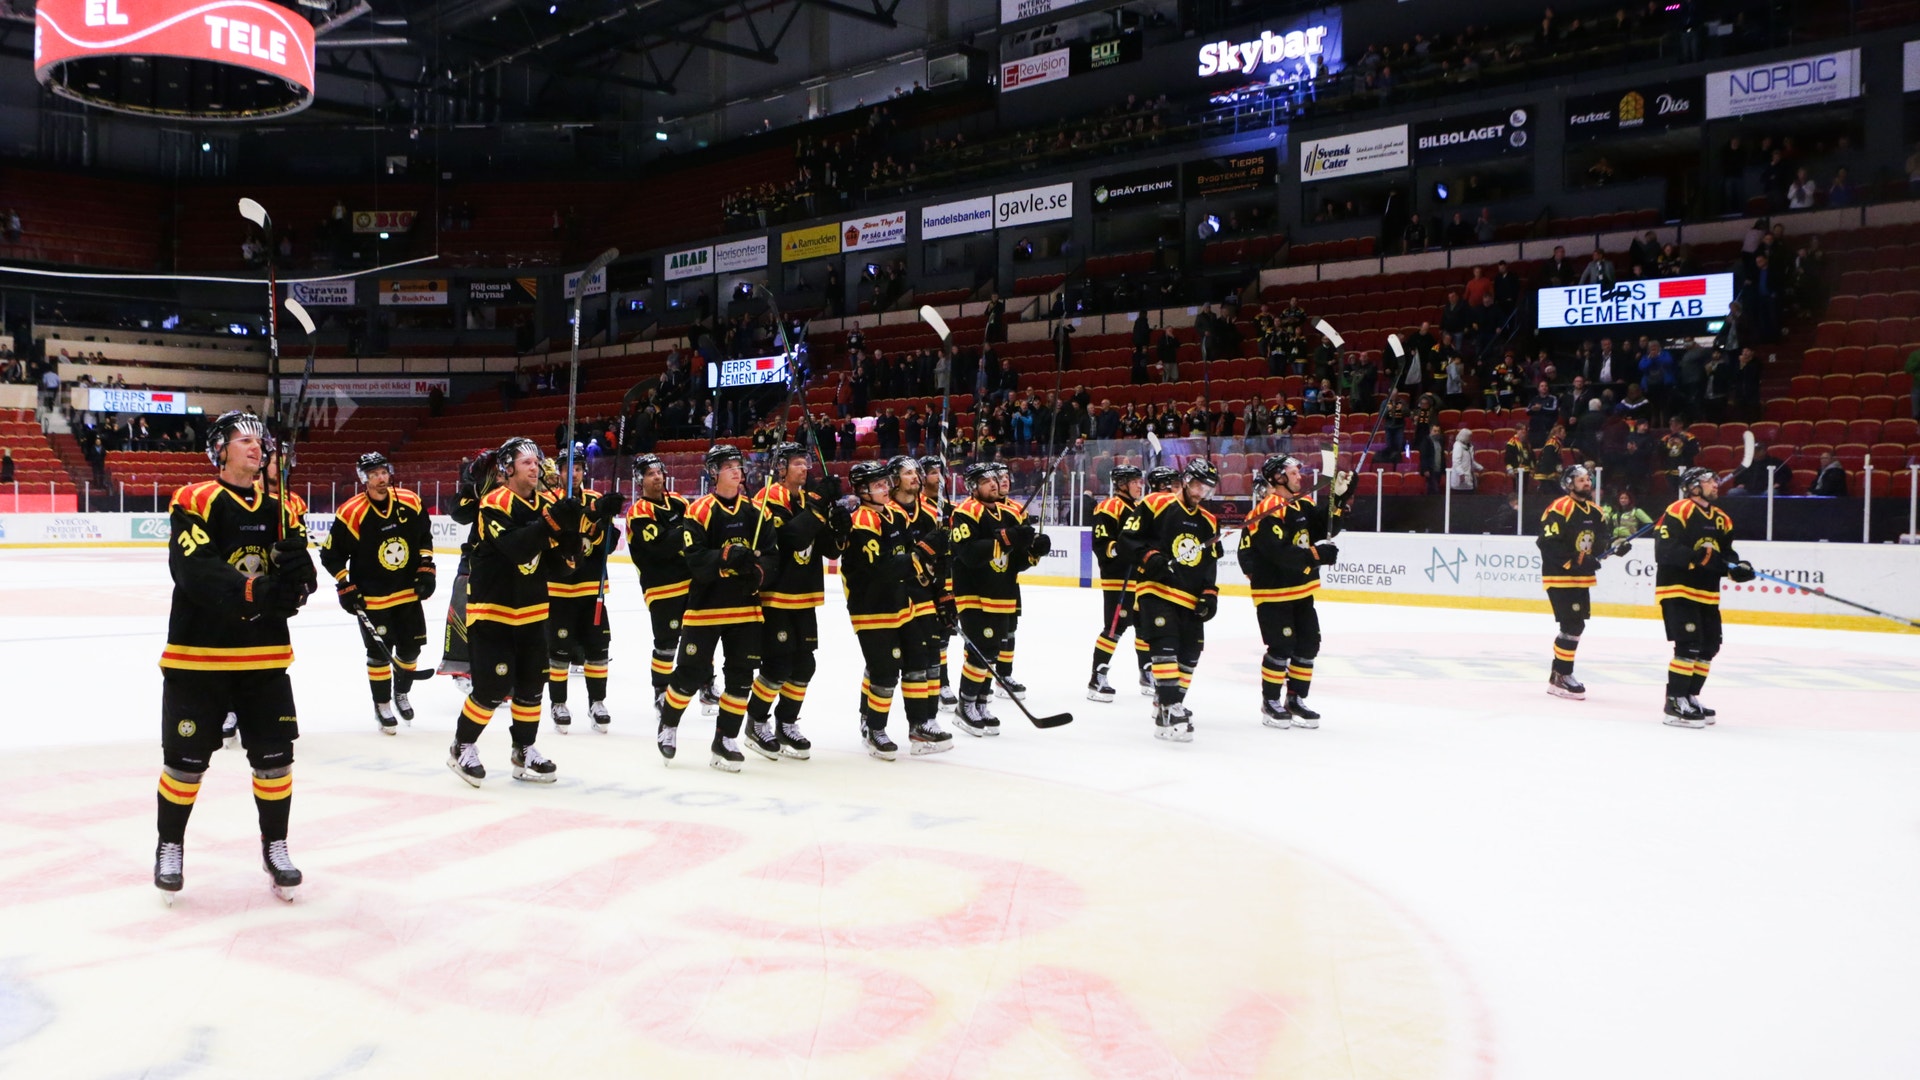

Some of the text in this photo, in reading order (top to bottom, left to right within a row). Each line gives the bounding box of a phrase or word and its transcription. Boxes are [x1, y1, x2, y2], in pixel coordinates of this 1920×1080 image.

[85, 0, 128, 26] EL
[1018, 3, 1051, 19] AKUSTIK
[204, 15, 287, 65] TELE
[1198, 25, 1327, 77] Skybar
[1020, 56, 1067, 77] Revision
[1730, 58, 1837, 97] NORDIC
[1419, 124, 1505, 149] BILBOLAGET
[1317, 143, 1351, 160] Svensk
[1322, 158, 1348, 171] Cater
[1000, 193, 1068, 222] gavle.se
[923, 208, 991, 229] Handelsbanken
[798, 233, 837, 249] Ramudden
[670, 249, 708, 269] ABAB
[716, 243, 766, 261] Horisonterra
[301, 285, 347, 294] Caravan
[1564, 283, 1646, 305] TIEPS
[308, 294, 348, 303] Marine
[1564, 300, 1703, 325] CEMENT AB
[720, 373, 757, 386] CEMENT
[104, 391, 146, 401] TIERPS
[104, 402, 172, 413] CEMENT AB
[398, 507, 408, 523] C
[1715, 516, 1725, 530] A
[953, 523, 971, 543] 88
[1045, 549, 1068, 559] arn
[1368, 564, 1407, 575] DELAR
[1326, 574, 1392, 586] SVERIGE AB
